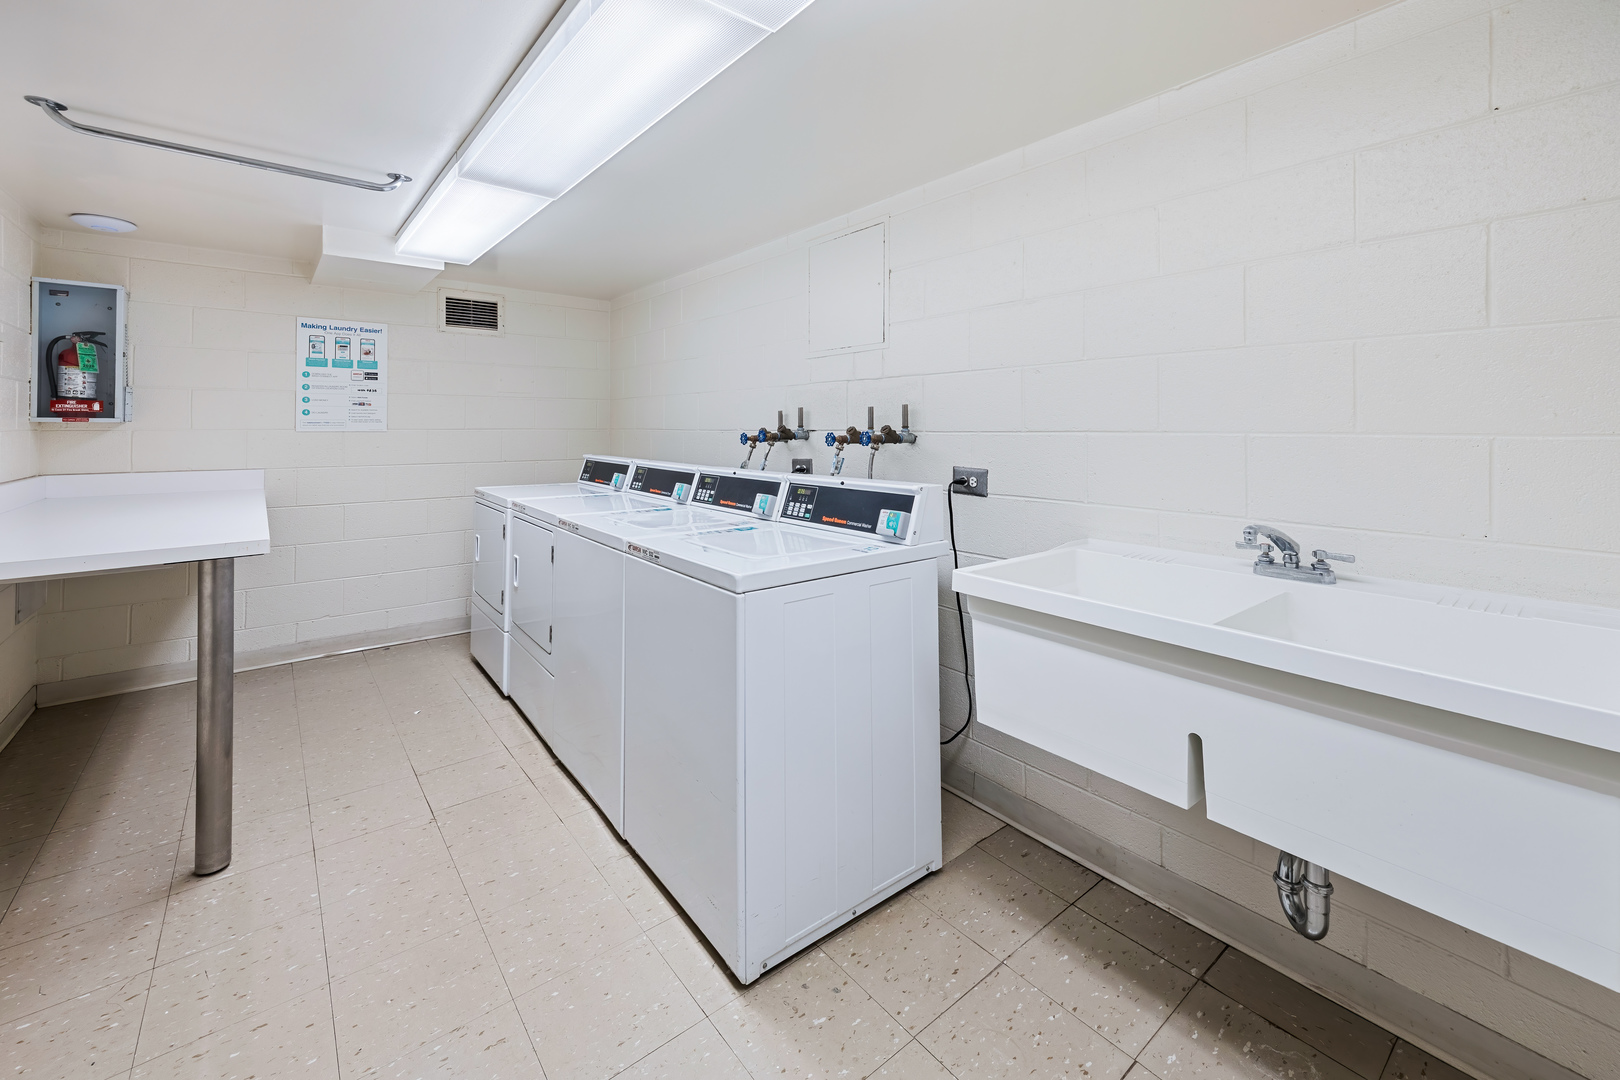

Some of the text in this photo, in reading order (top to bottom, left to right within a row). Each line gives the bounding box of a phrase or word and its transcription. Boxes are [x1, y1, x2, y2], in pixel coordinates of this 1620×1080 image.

[301, 322, 383, 334] Making Laundry Easier!
